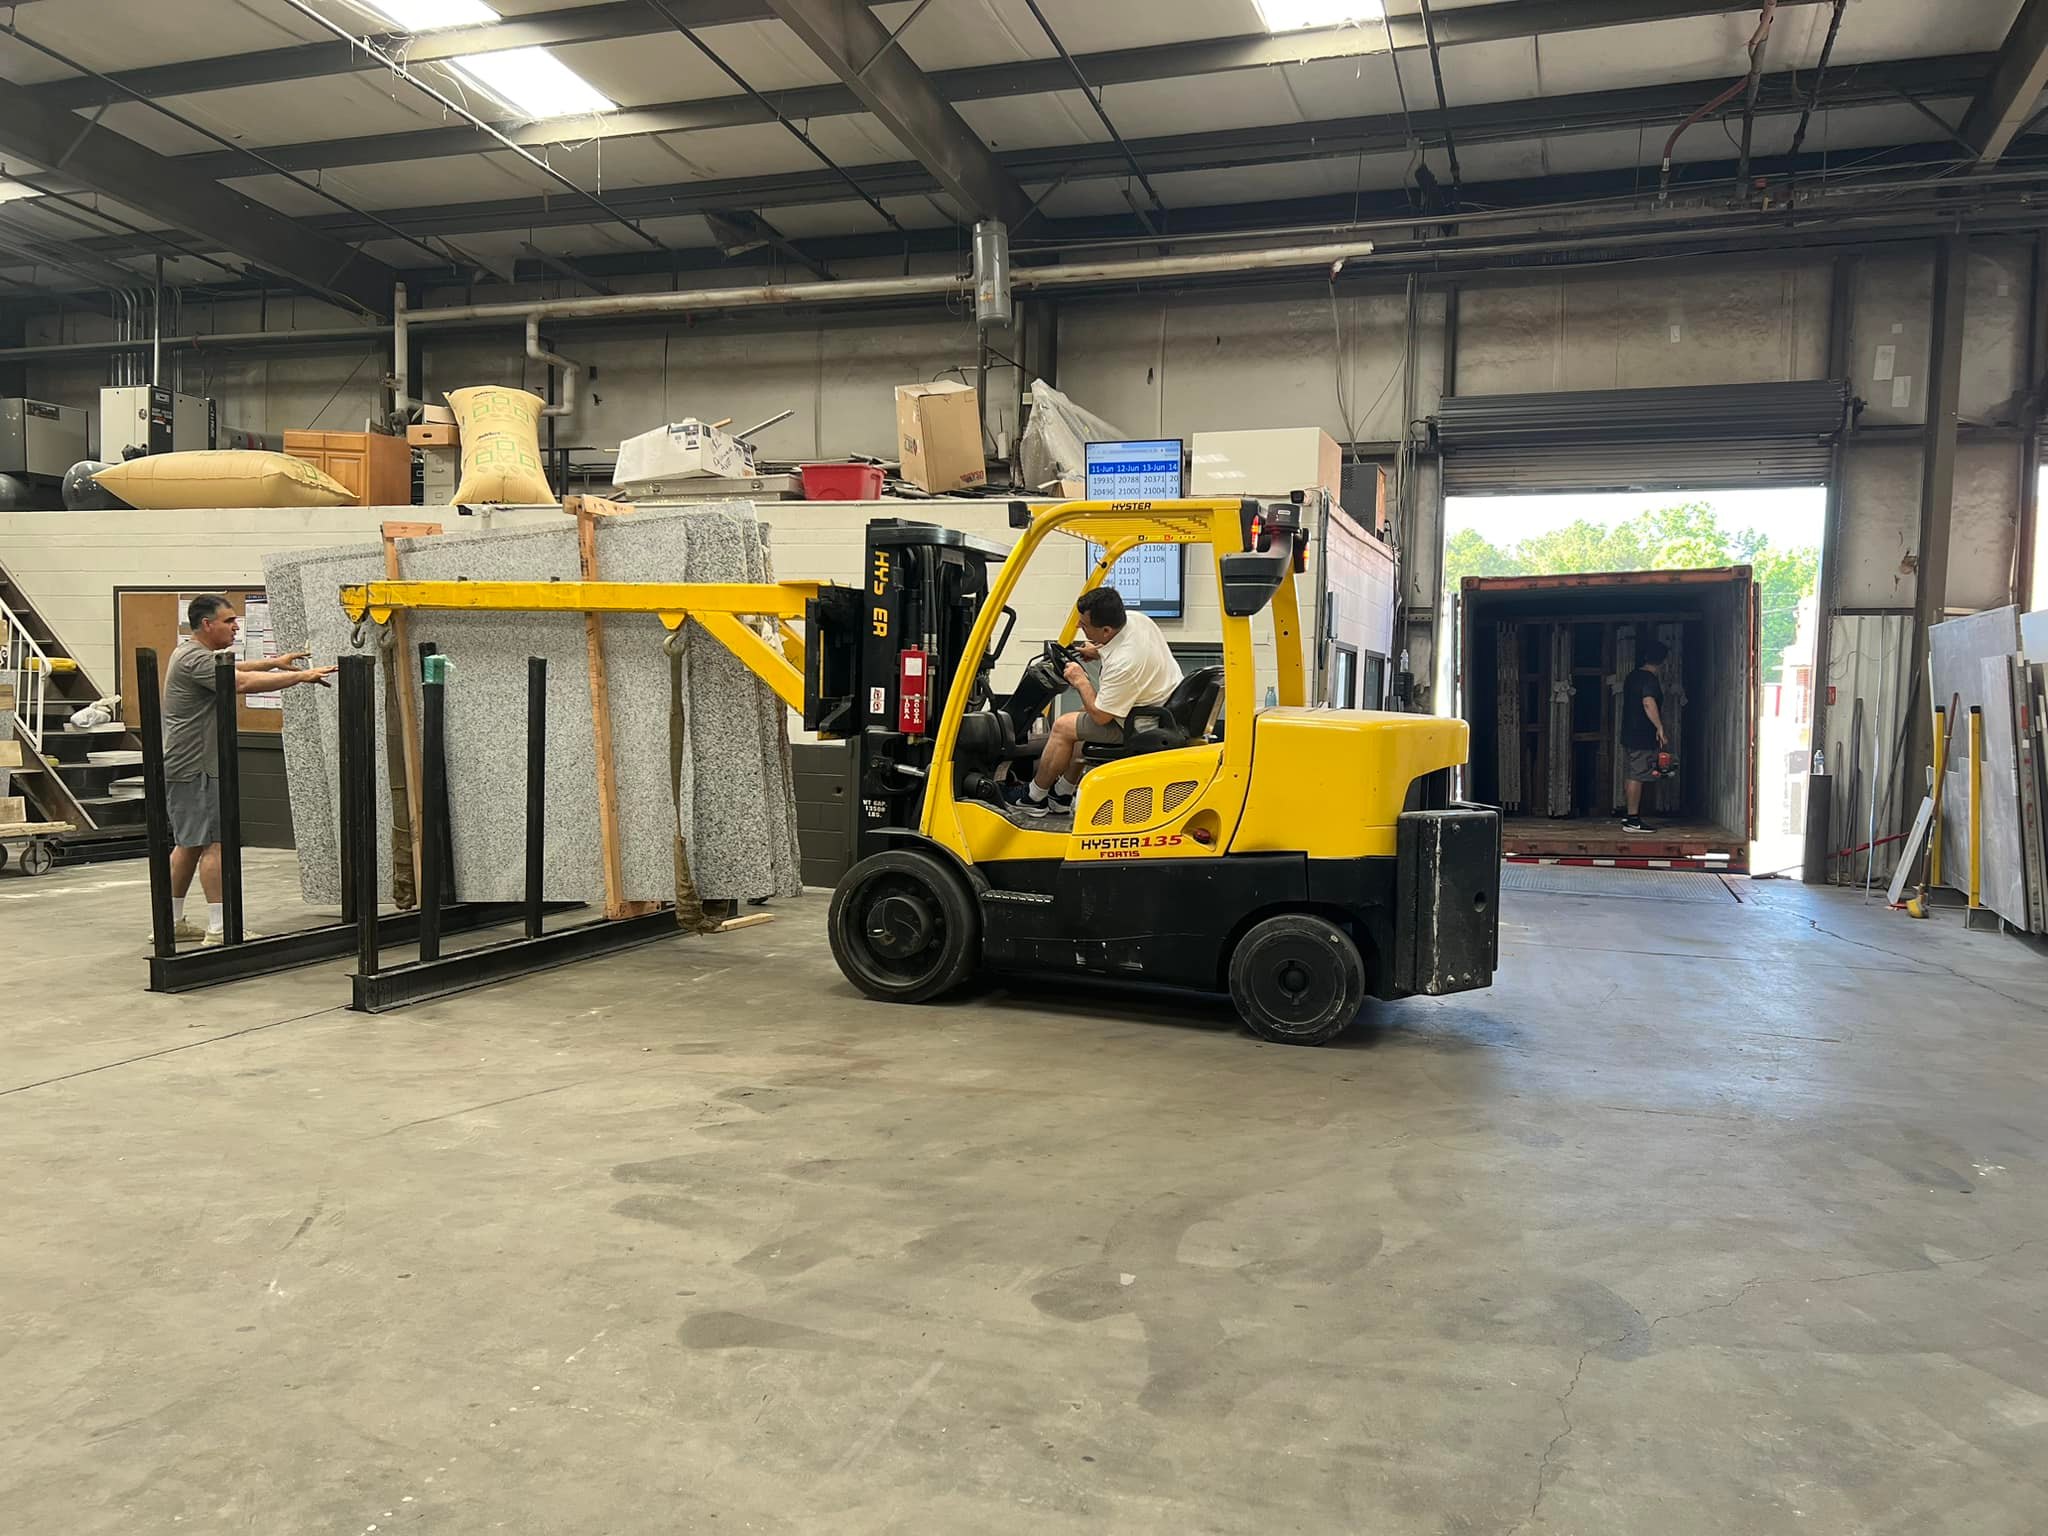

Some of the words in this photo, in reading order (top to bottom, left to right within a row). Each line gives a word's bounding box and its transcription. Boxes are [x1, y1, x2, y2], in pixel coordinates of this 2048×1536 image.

[1092, 465, 1114, 473] 11-Jun
[1117, 464, 1140, 473] 12-Jun
[1143, 463, 1166, 472] 13-Jun
[1143, 475, 1165, 483] 20371
[1118, 488, 1140, 496] 21000
[1143, 487, 1165, 495] 21004
[1111, 502, 1152, 512] HYSTER
[1118, 567, 1140, 575] 21107
[1118, 579, 1140, 587] 21112
[1081, 838, 1140, 850] HYSTER
[1141, 835, 1183, 847] 135
